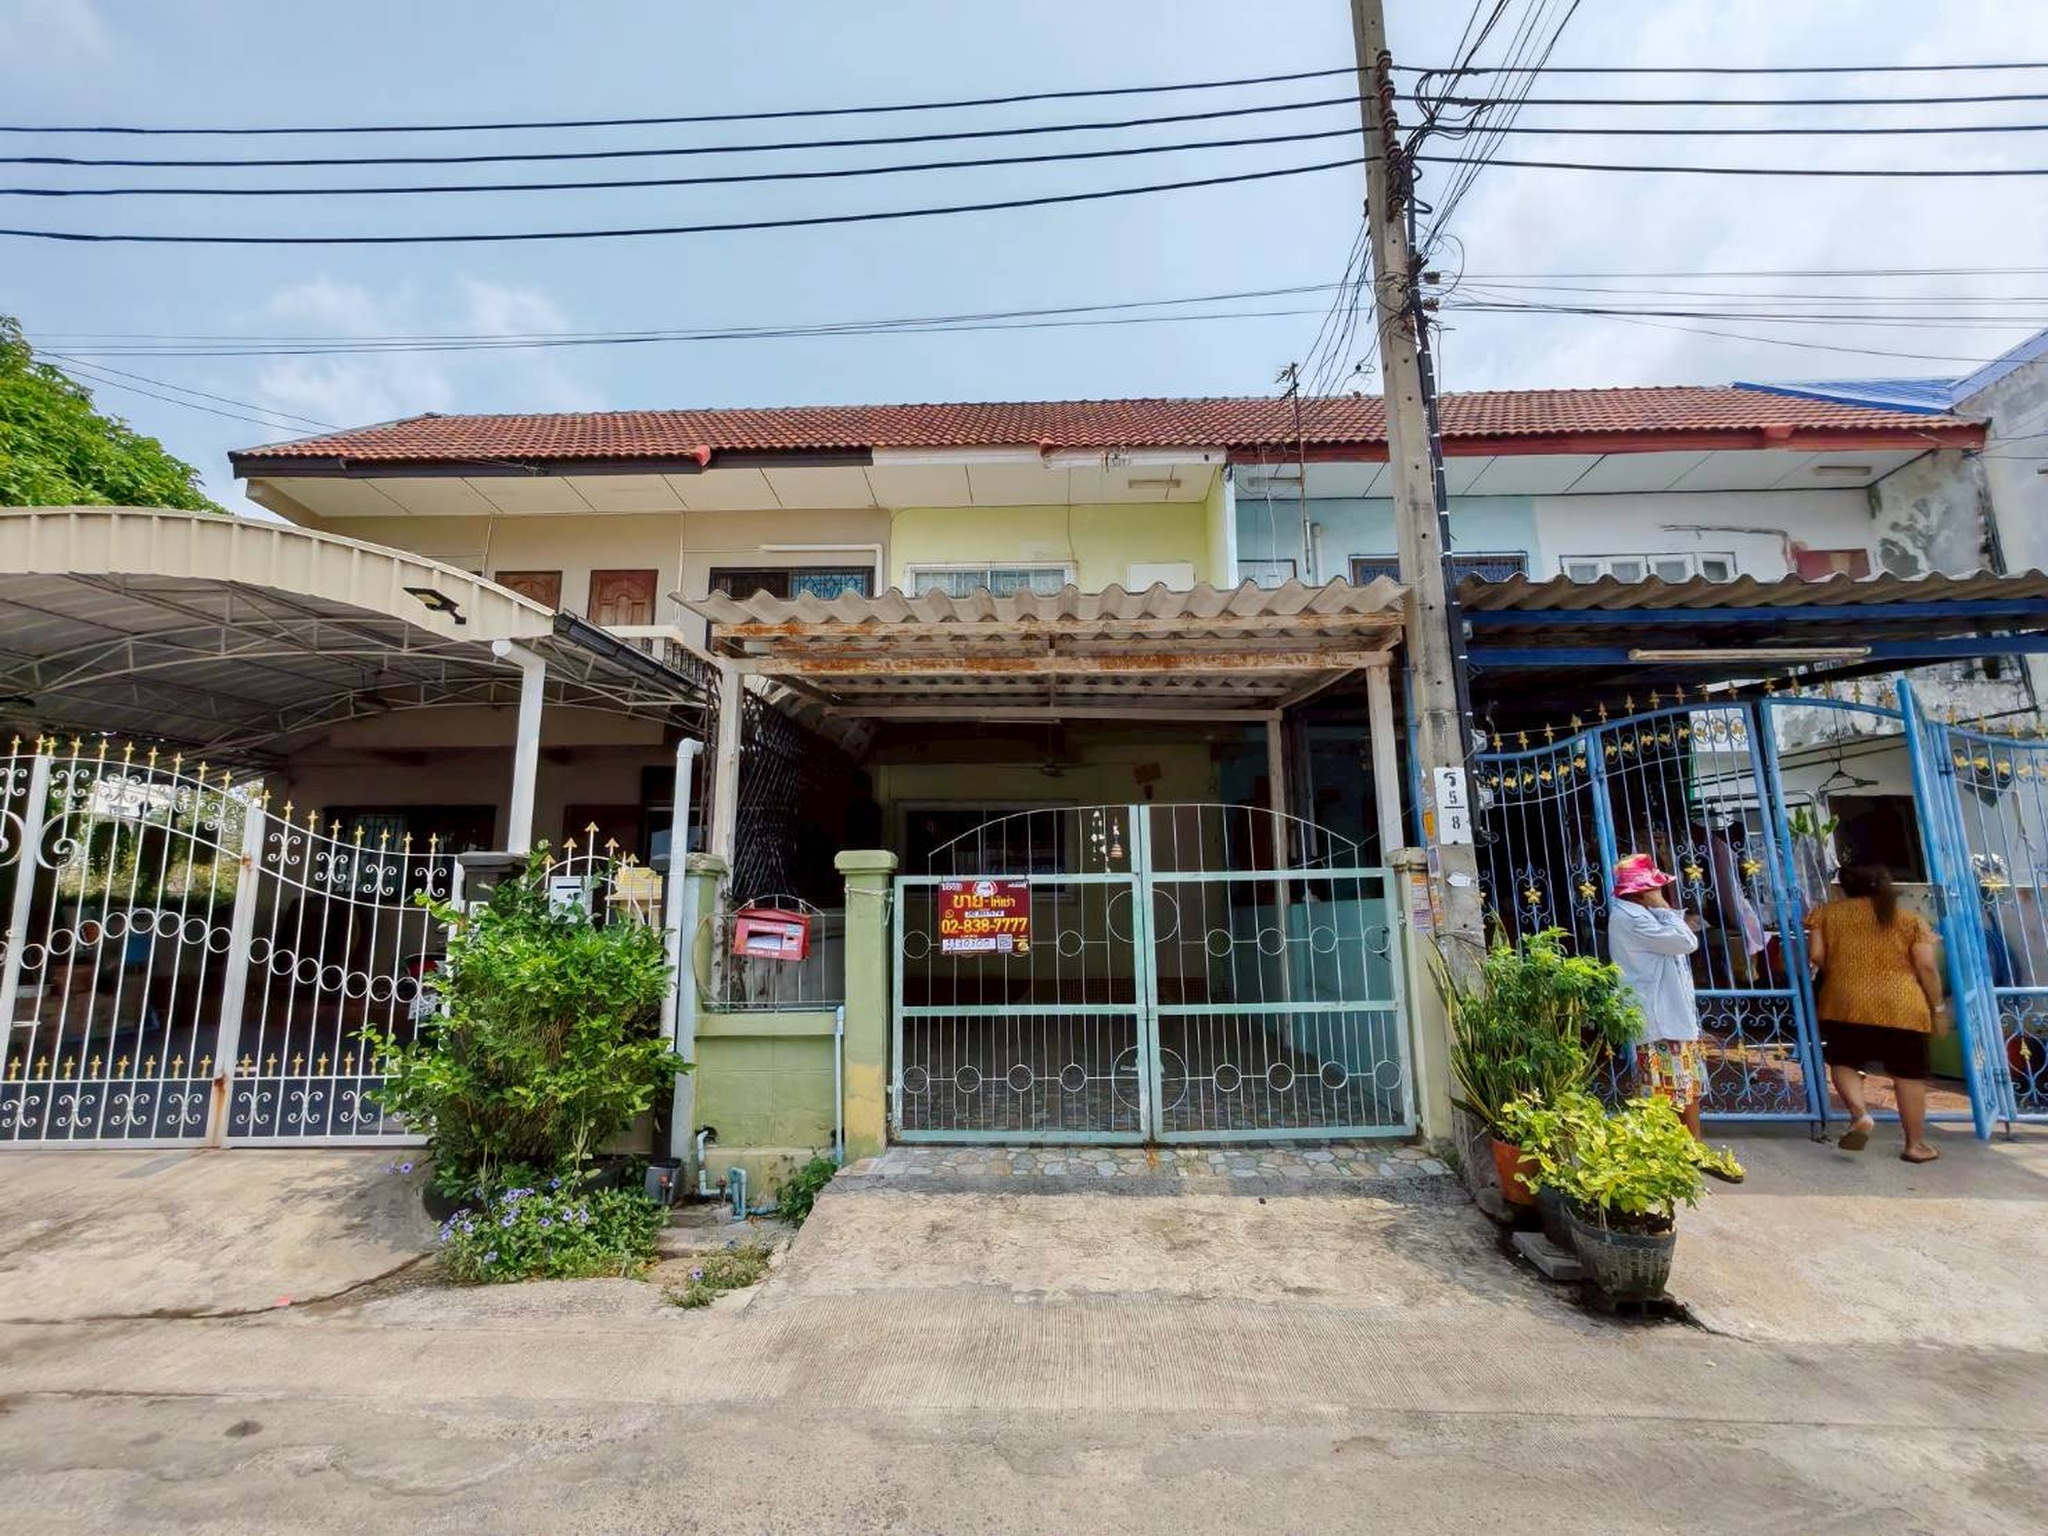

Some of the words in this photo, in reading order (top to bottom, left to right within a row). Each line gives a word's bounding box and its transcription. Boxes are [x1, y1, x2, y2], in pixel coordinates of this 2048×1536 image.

[1449, 790, 1457, 804] 5
[1452, 815, 1461, 829] 8
[941, 917, 1028, 934] 02-838-7777
